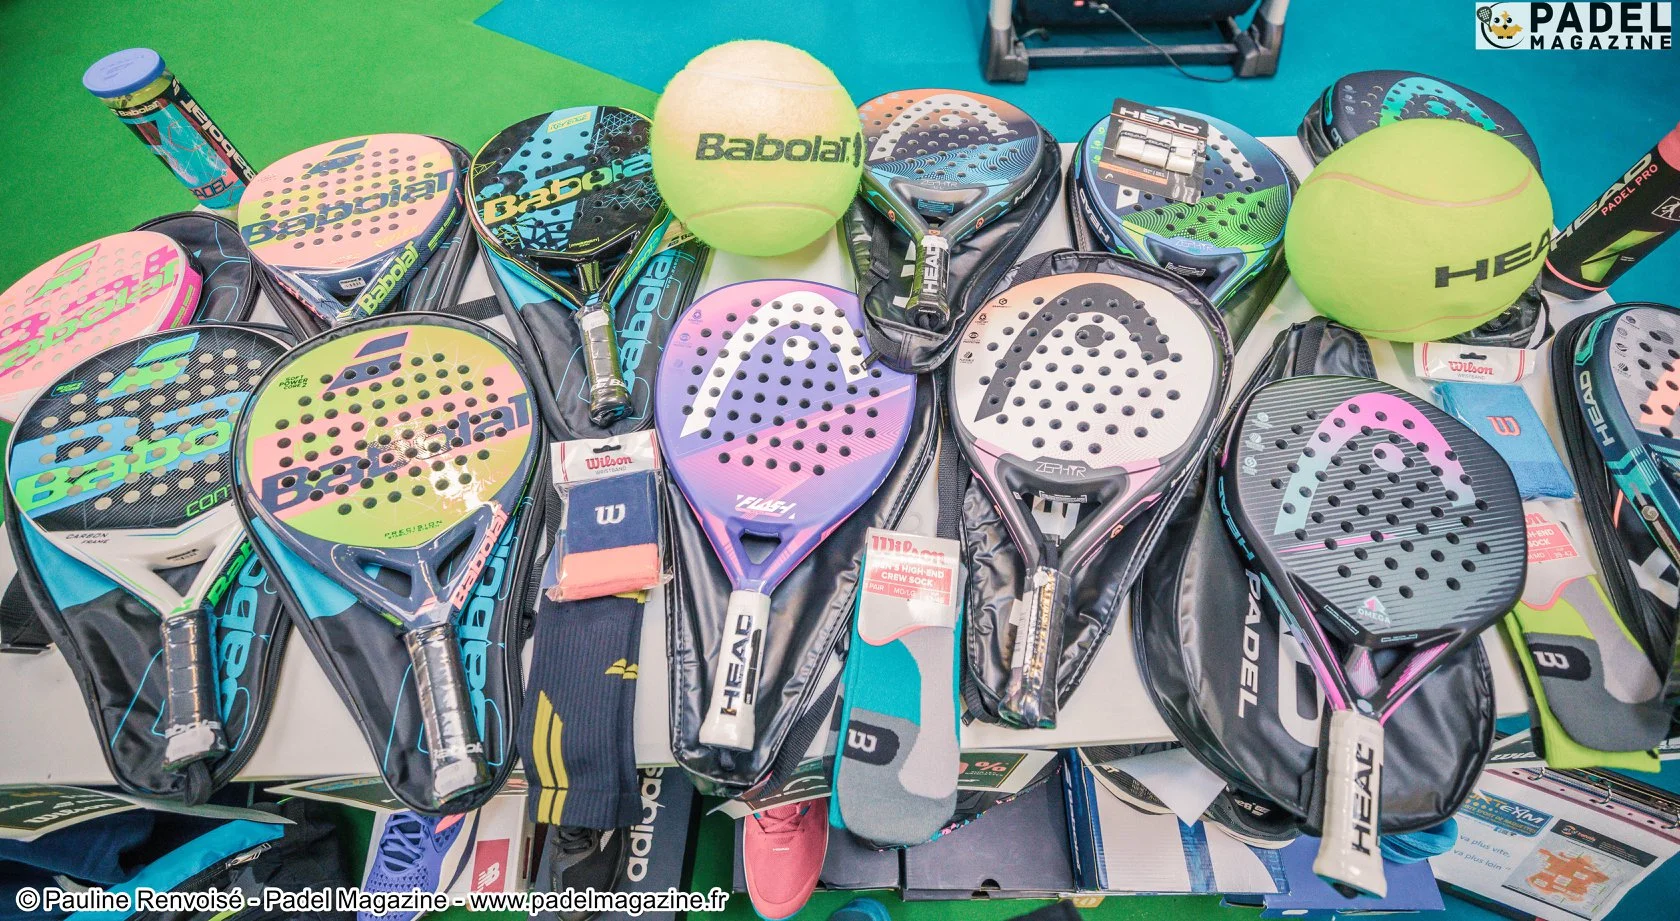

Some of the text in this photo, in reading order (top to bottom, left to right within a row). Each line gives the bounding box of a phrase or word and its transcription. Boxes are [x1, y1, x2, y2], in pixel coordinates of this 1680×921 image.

[1120, 107, 1199, 134] HEAD
[484, 151, 652, 226] Babola
[1551, 153, 1652, 251] HEAD
[1601, 164, 1659, 216] PADEL PRO
[1079, 187, 1112, 243] HEAD
[1435, 228, 1551, 288] HEA
[0, 259, 180, 370] abolat
[1449, 361, 1494, 376] Wilson
[1579, 370, 1616, 447] HEAD
[15, 411, 233, 513] Babo
[586, 455, 633, 470] Wilson
[1035, 462, 1087, 478] ZEPHYR
[736, 496, 797, 514] FLASH
[1218, 476, 1255, 561] HEAD
[869, 583, 885, 591] PAIR
[881, 571, 934, 587] CREW SOCK
[902, 564, 945, 578] HIGH-END
[1357, 607, 1391, 625] OMEGA
[1238, 568, 1262, 719] PADEL
[720, 614, 753, 716] HEAD
[1464, 853, 1483, 864] plus
[1484, 861, 1502, 871] loin
[1471, 839, 1490, 850] plus
